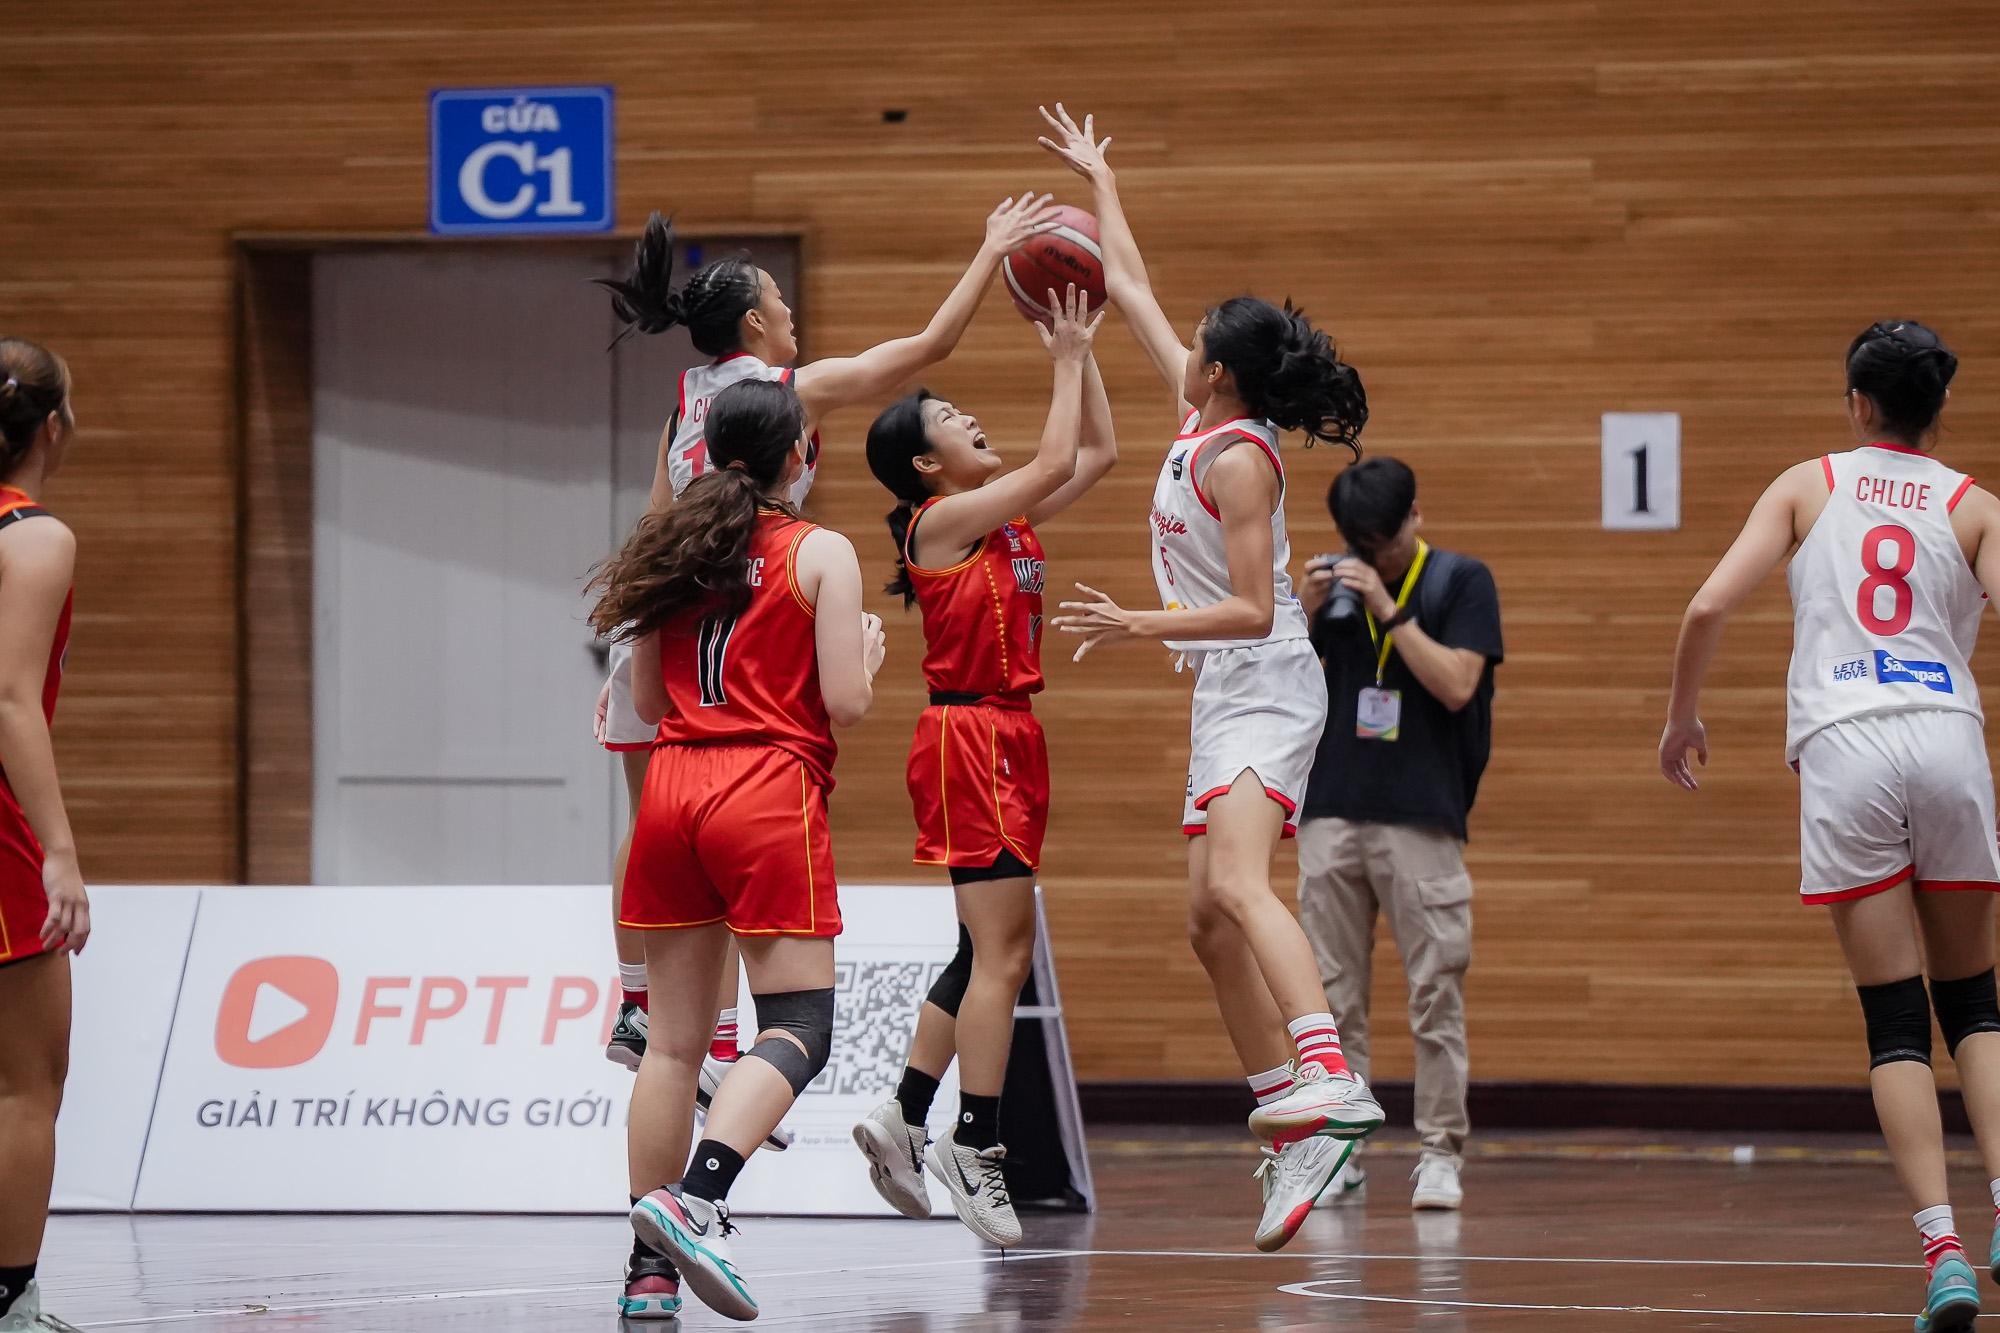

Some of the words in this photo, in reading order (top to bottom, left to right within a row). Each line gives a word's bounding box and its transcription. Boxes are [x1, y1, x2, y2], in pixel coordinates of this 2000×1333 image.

[457, 140, 586, 220] C1
[1622, 440, 1657, 517] 1
[1856, 476, 1931, 511] CHLOE
[1857, 524, 1916, 637] 8
[1832, 667, 1868, 682] MOVE
[1882, 656, 1946, 683] Sanpas
[352, 975, 530, 1046] FPT
[196, 1089, 279, 1128] GIẢI
[292, 1089, 357, 1127] TRÍ
[362, 1089, 511, 1127] KHÔNG
[524, 1089, 613, 1127] GIỚI
